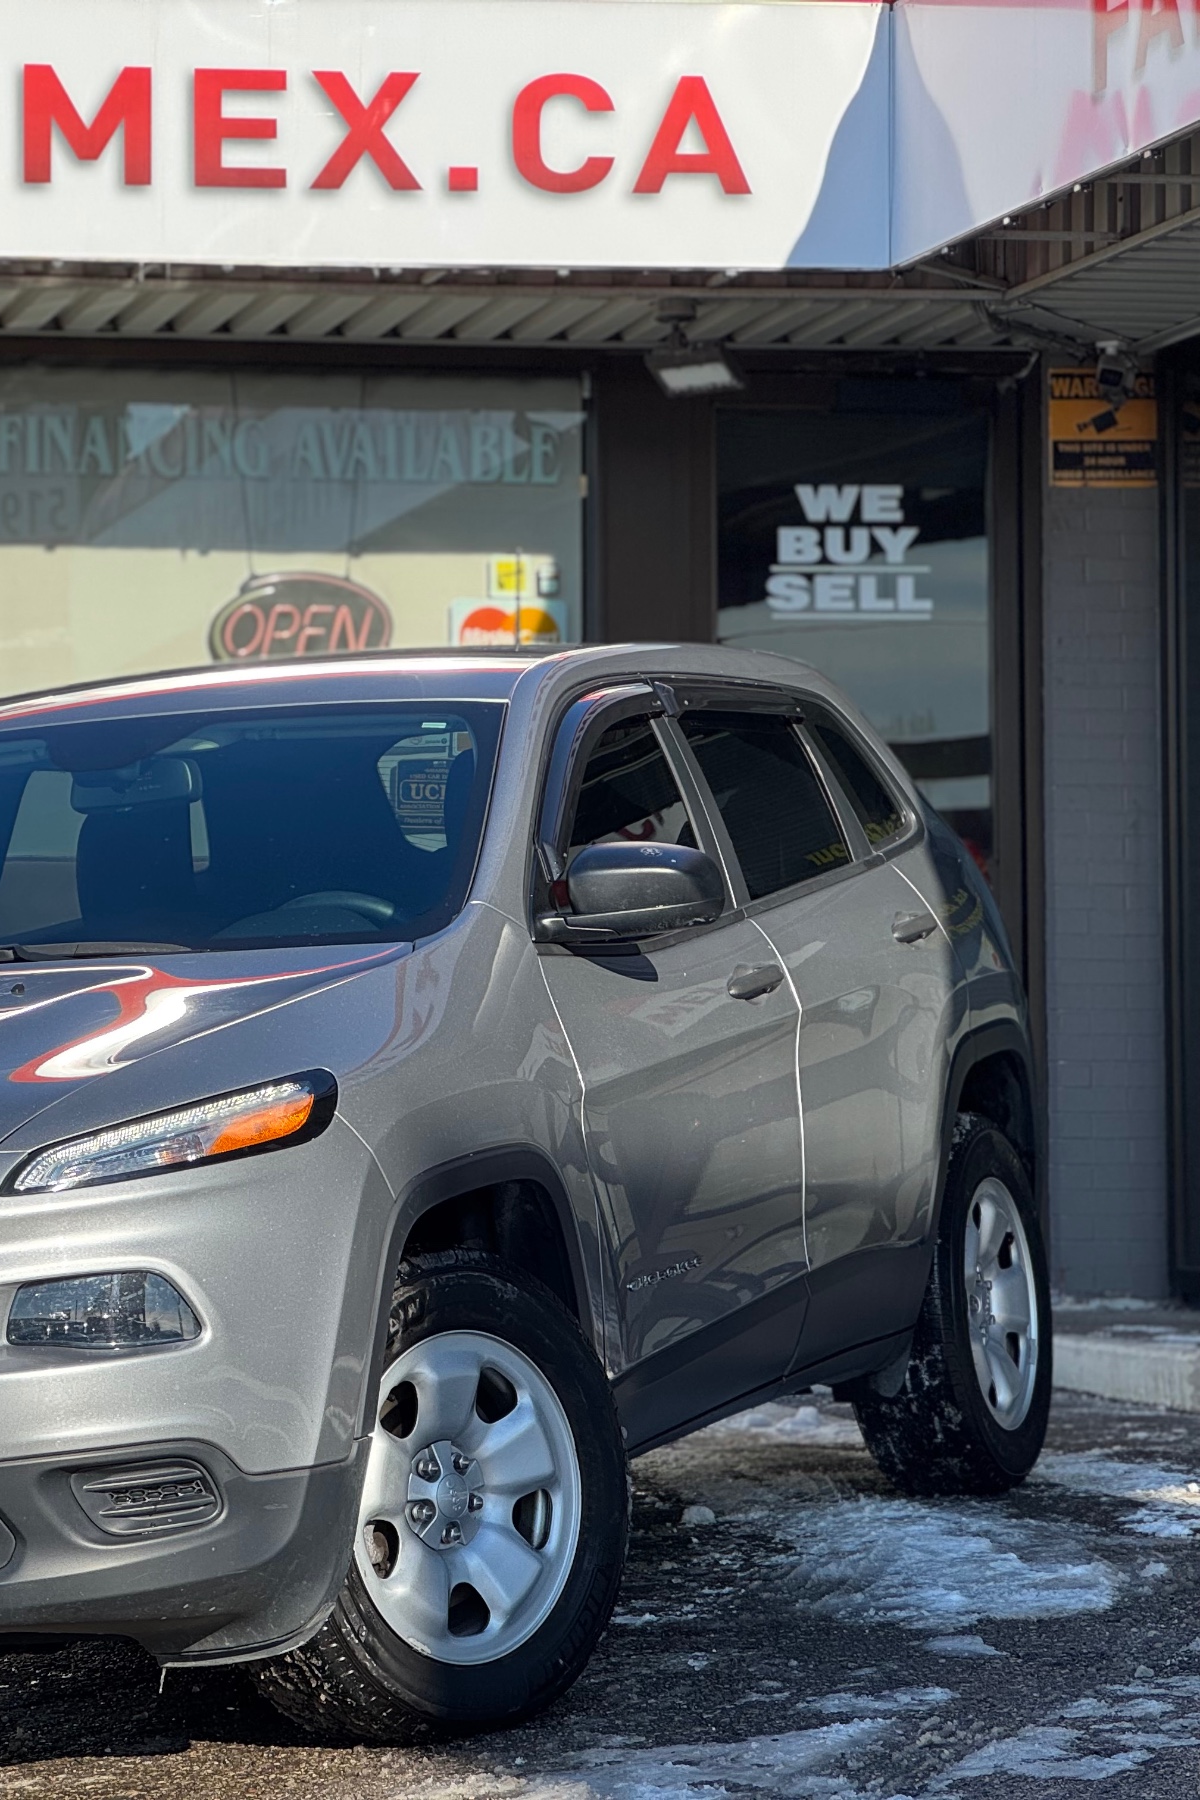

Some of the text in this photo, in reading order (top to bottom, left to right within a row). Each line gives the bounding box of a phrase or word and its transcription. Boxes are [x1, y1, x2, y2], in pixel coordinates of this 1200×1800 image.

[1052, 376, 1155, 397] WARG!
[296, 418, 562, 486] AVAILABLE
[795, 484, 904, 523] WE
[777, 527, 920, 564] BUY
[765, 574, 933, 611] SELL
[223, 602, 375, 660] OPEN
